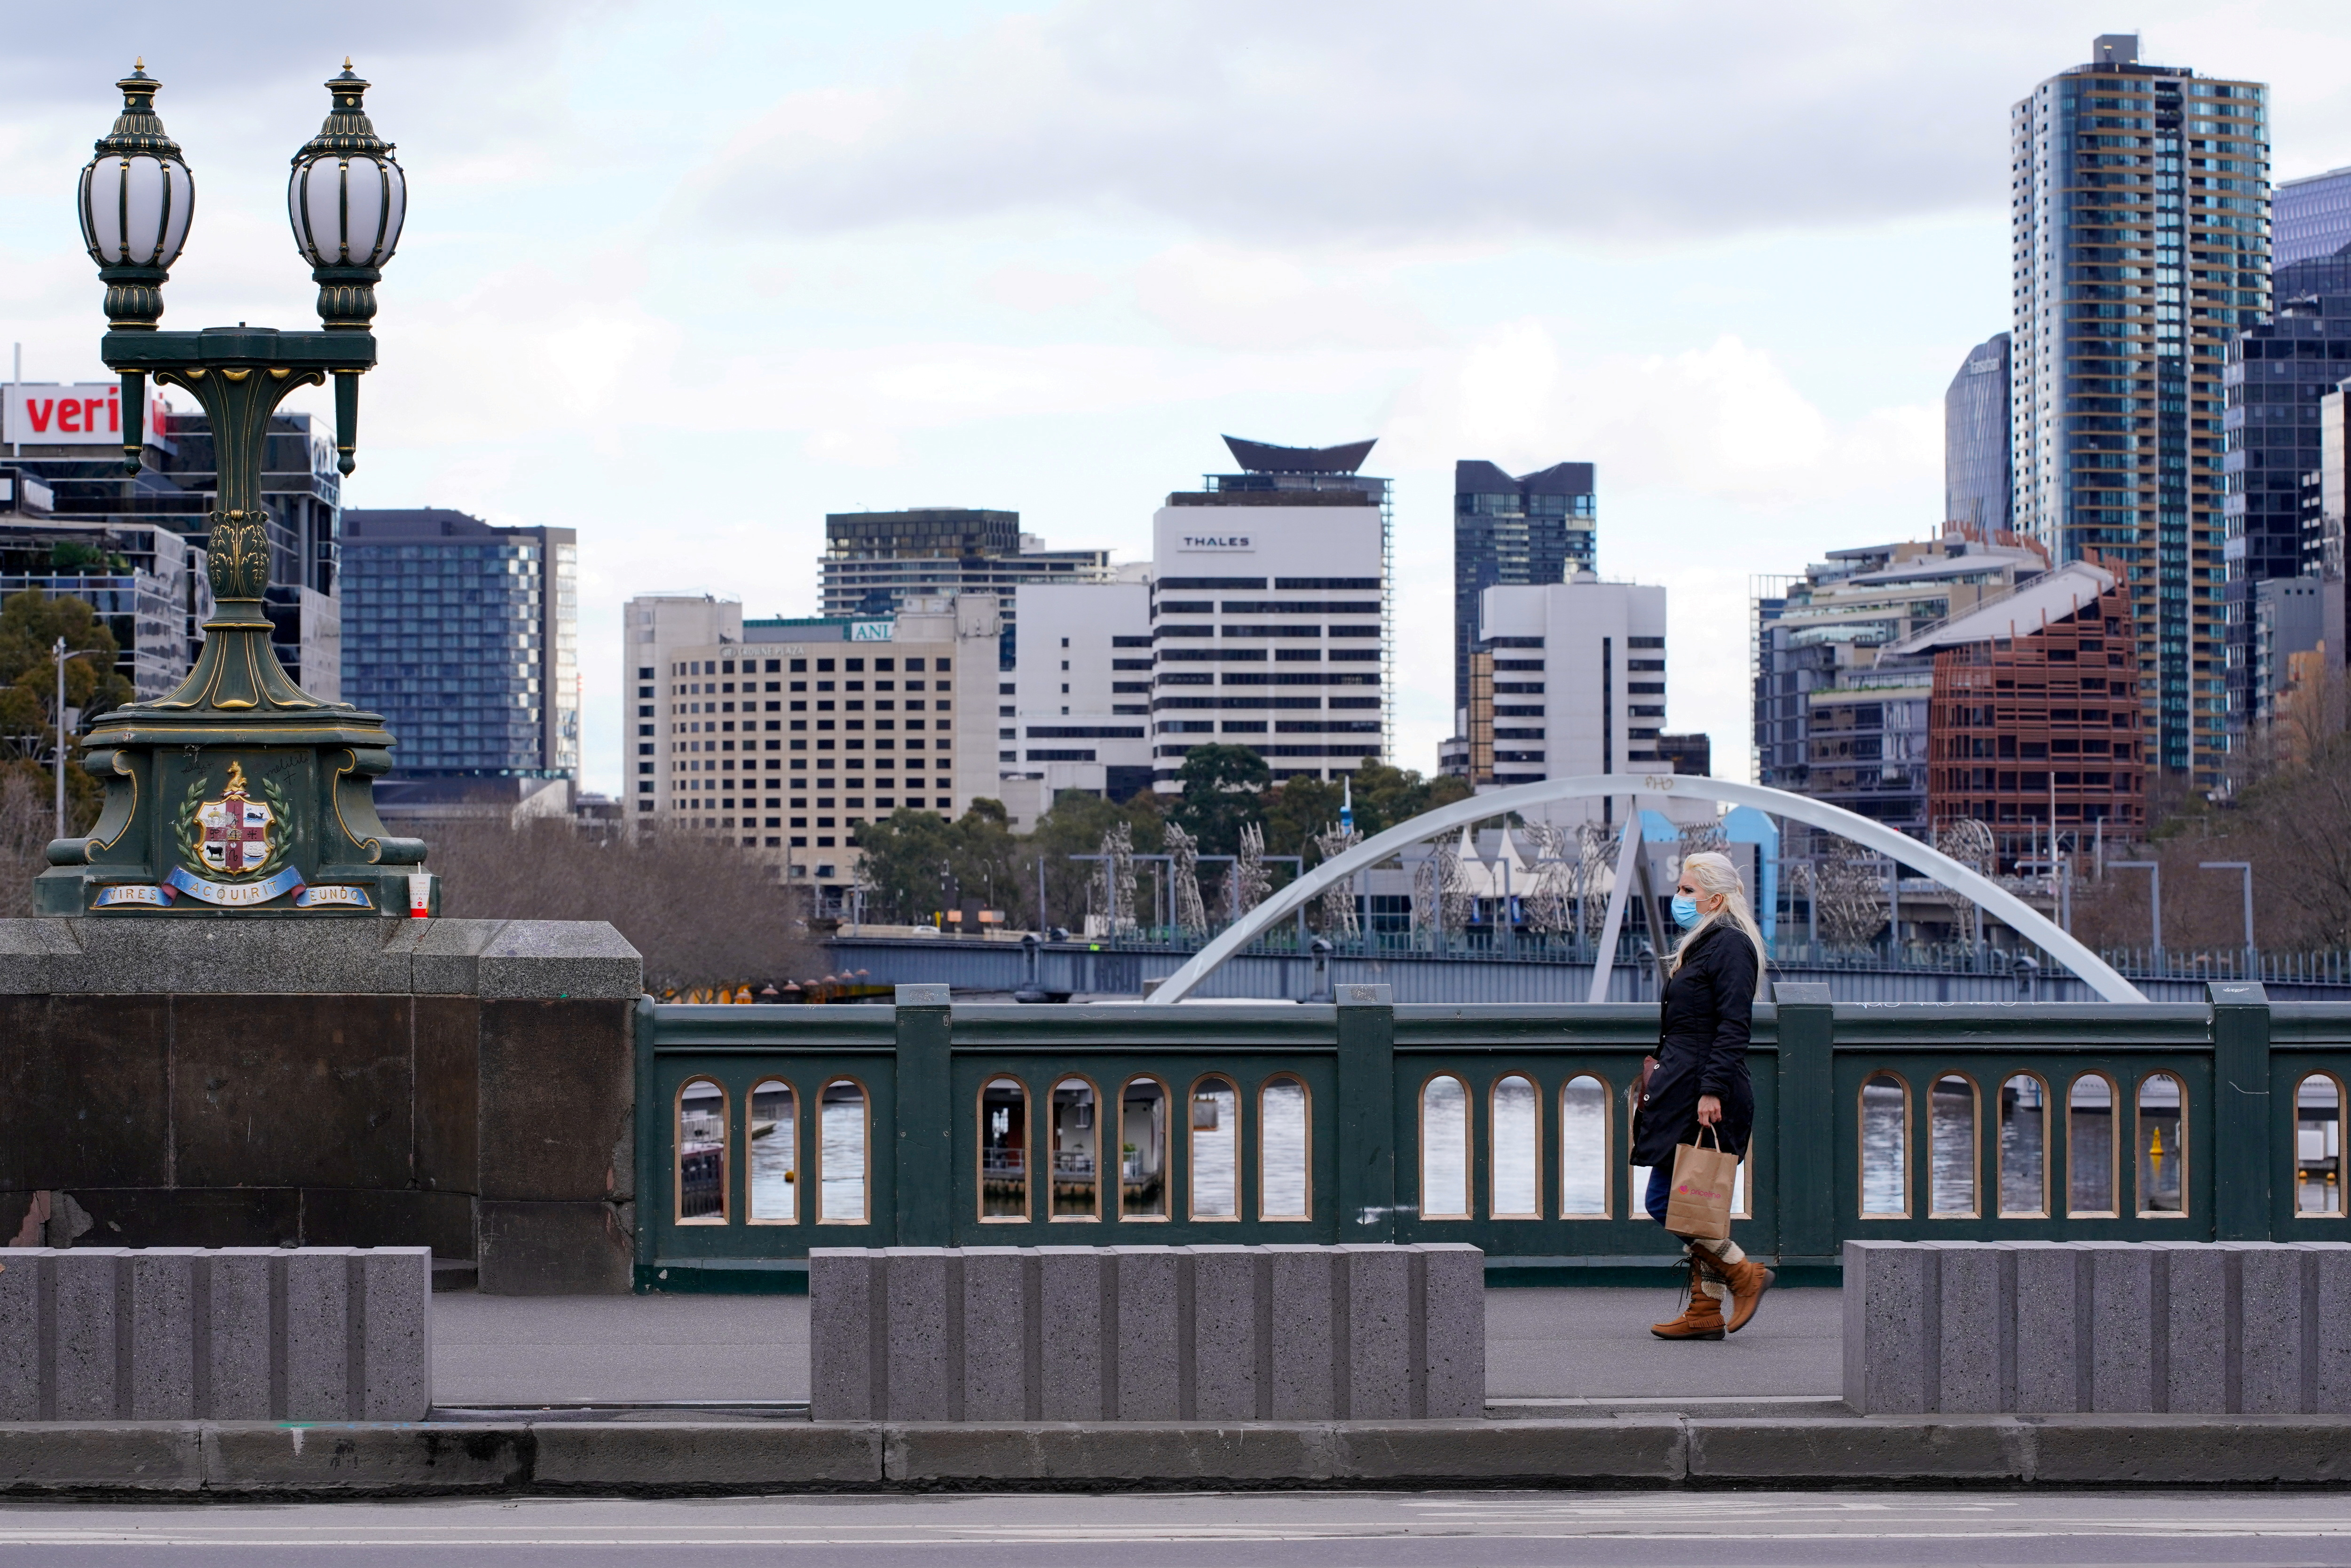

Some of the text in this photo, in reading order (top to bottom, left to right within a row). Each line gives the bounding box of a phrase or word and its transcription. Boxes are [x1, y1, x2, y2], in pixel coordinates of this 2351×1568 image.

[27, 387, 145, 432] veri
[1183, 537, 1249, 546] THALES
[855, 624, 892, 639] ANL
[738, 646, 805, 656] CROWNE PLAZA
[108, 880, 358, 901] VIRES ACQUIRIT EUNDO
[1690, 1189, 1721, 1198] priceline
